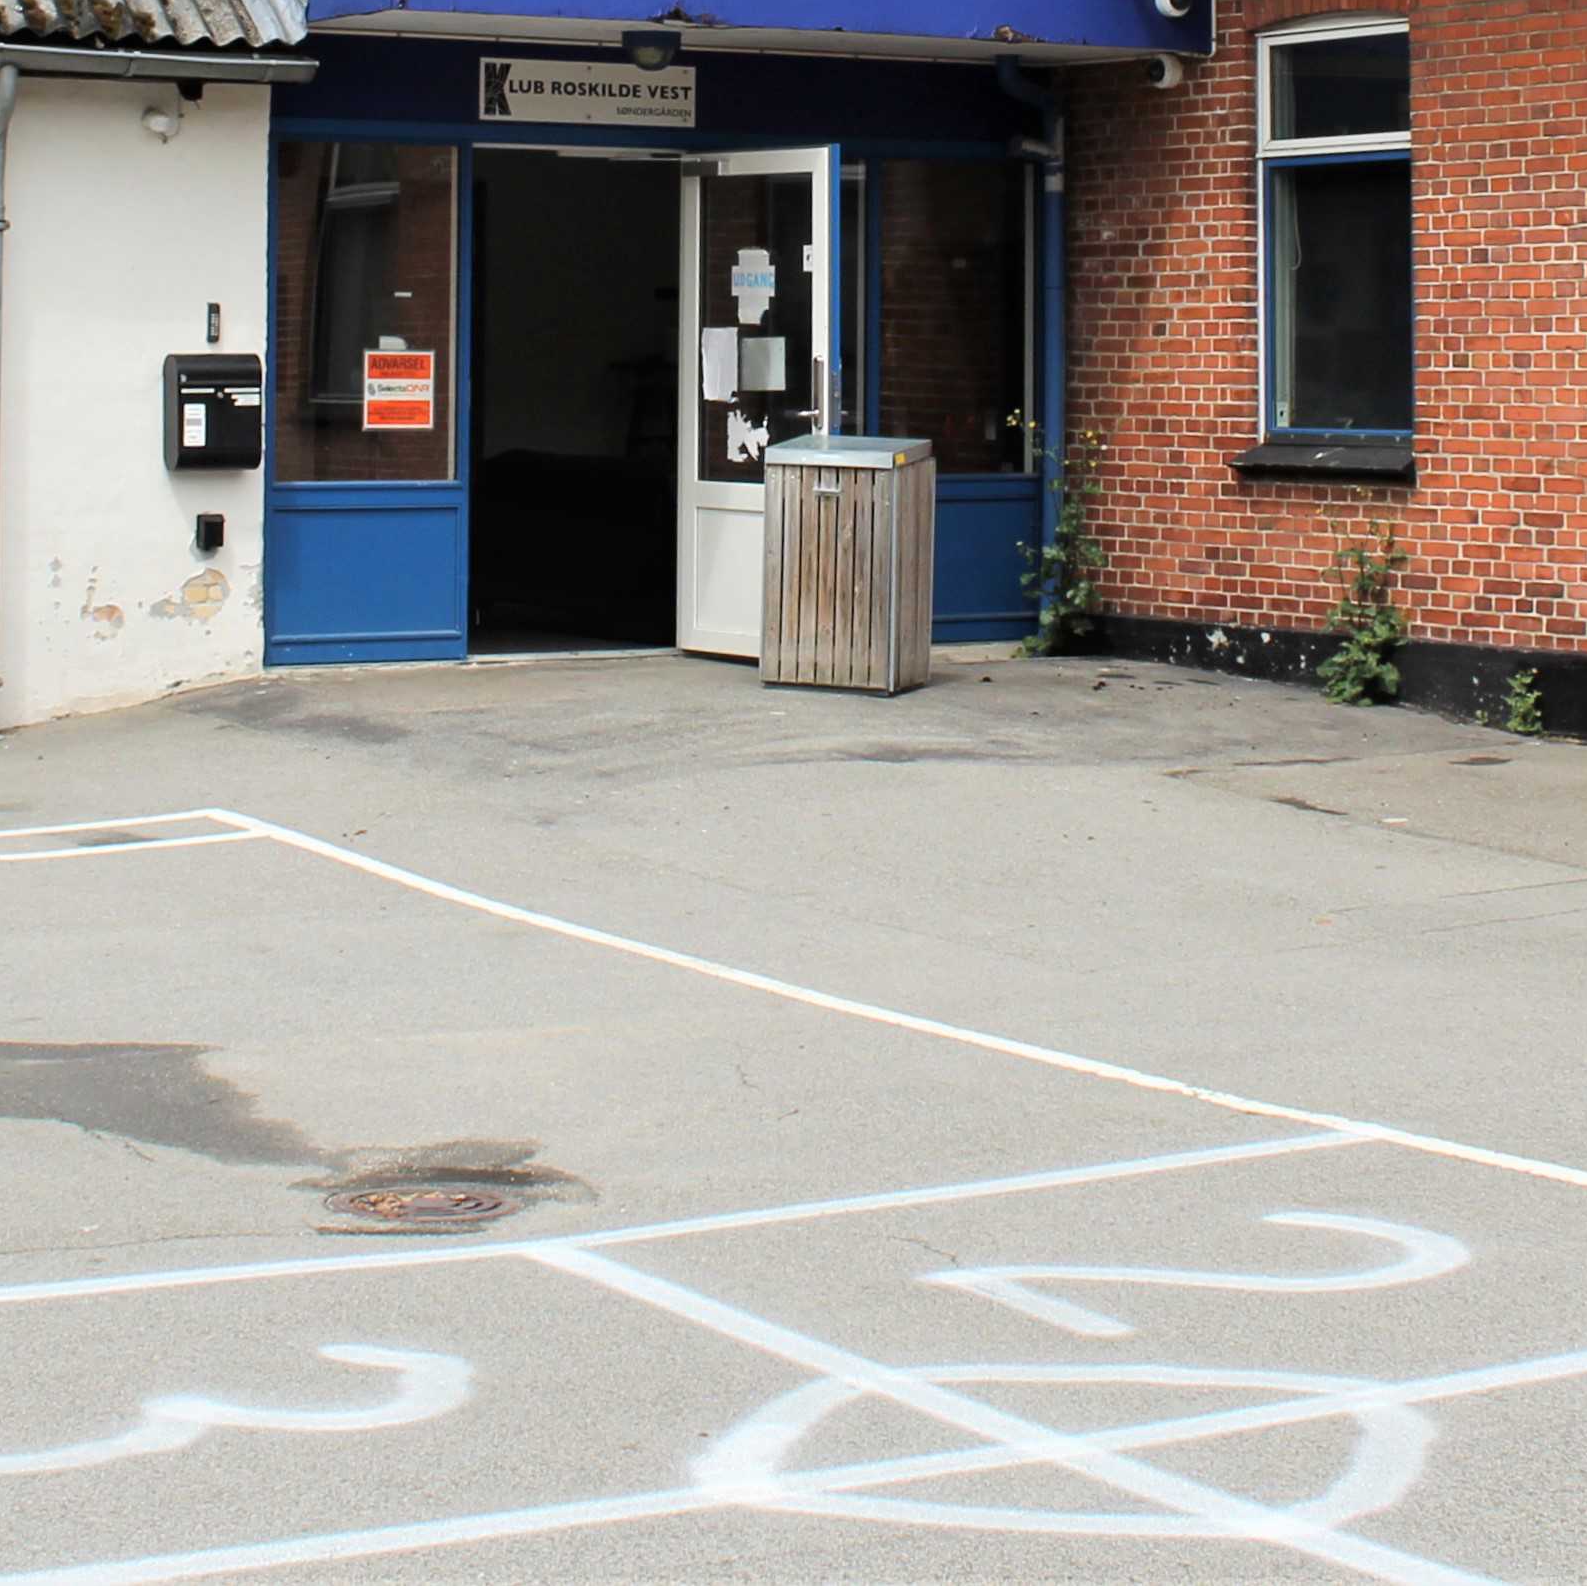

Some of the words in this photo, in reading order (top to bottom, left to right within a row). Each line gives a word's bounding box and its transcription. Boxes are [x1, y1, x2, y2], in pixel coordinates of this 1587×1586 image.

[484, 63, 545, 115] KLUB
[551, 81, 642, 99] ROSKILDE
[647, 85, 692, 101] VEST
